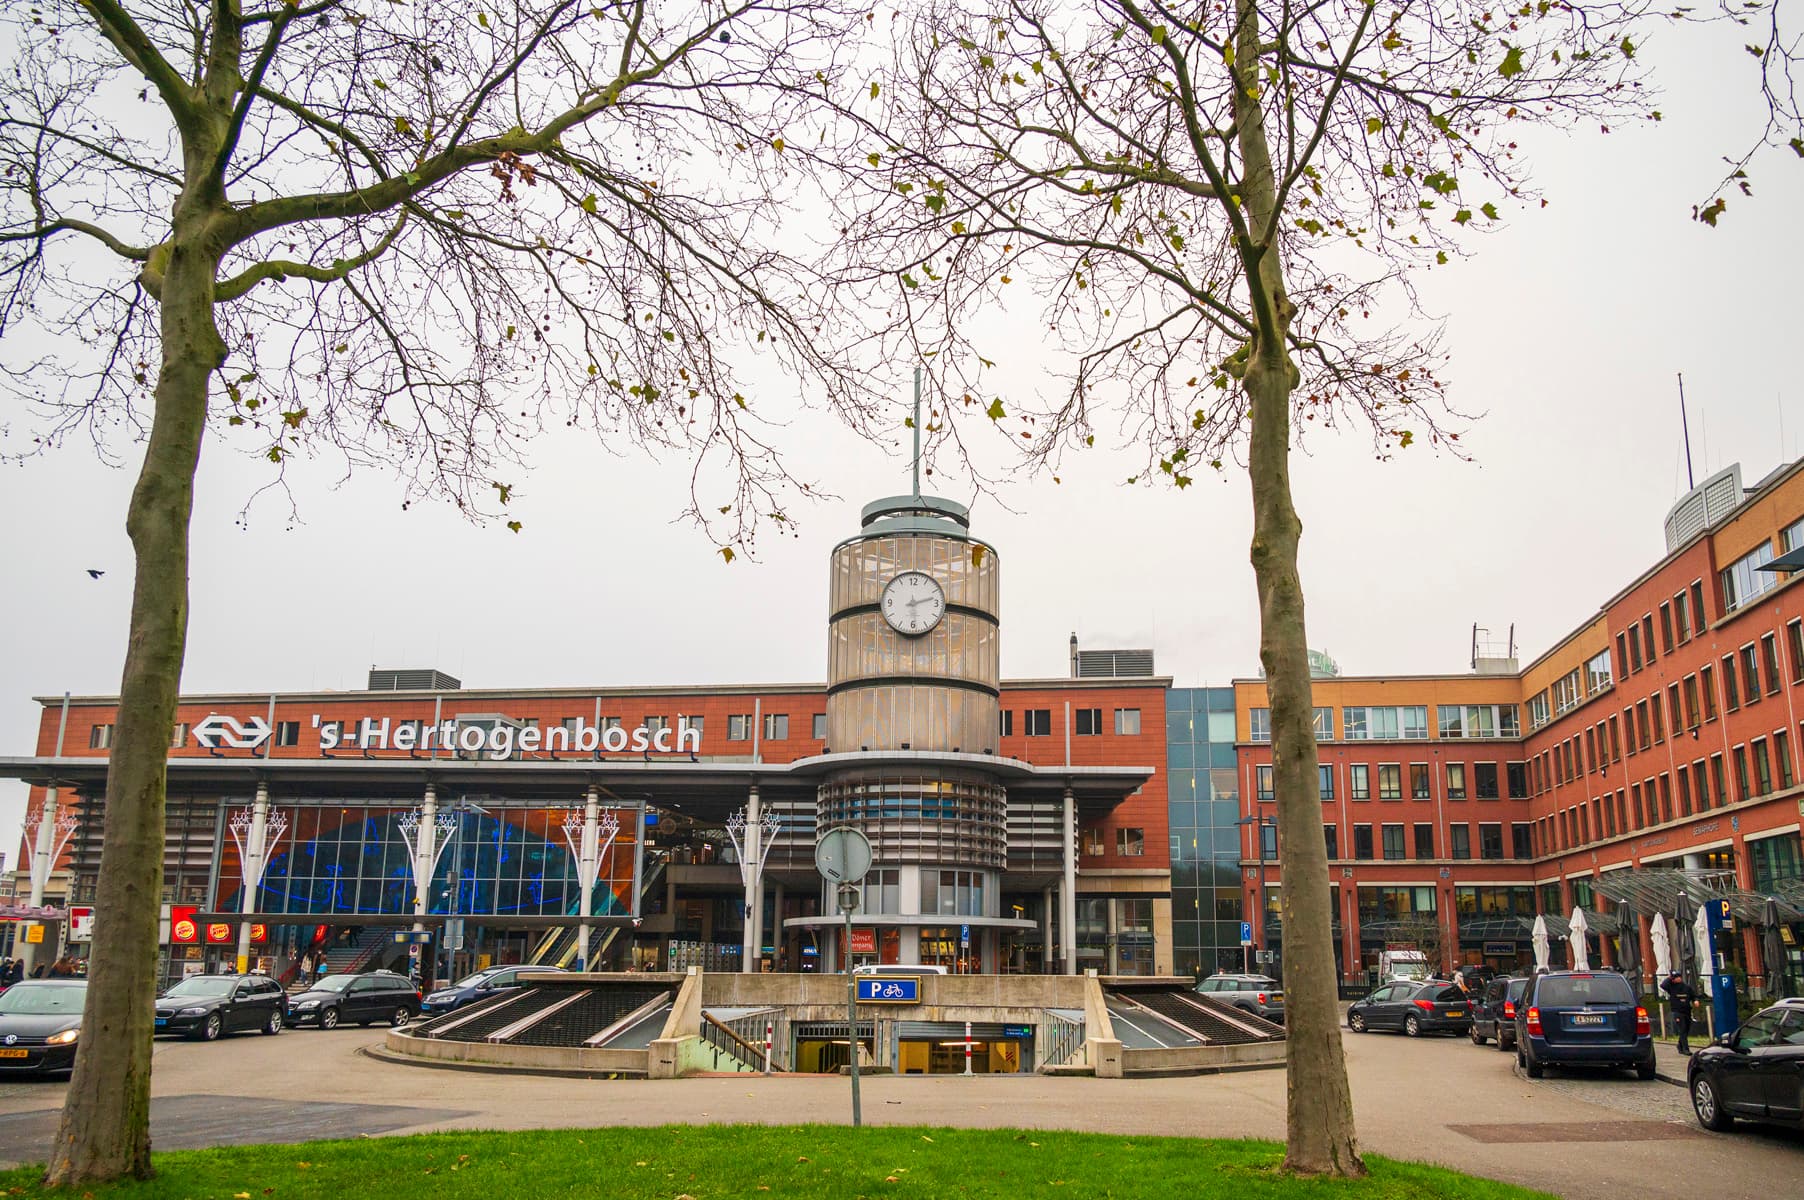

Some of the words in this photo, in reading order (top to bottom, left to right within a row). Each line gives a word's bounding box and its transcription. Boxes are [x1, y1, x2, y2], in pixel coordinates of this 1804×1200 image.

[909, 577, 918, 586] 12
[887, 598, 893, 608] 9
[933, 599, 940, 608] 3
[910, 620, 916, 629] 6
[312, 714, 700, 761] 's-Hertogenbosch
[1721, 901, 1730, 917] P
[1722, 976, 1729, 987] P
[871, 982, 882, 998] P
